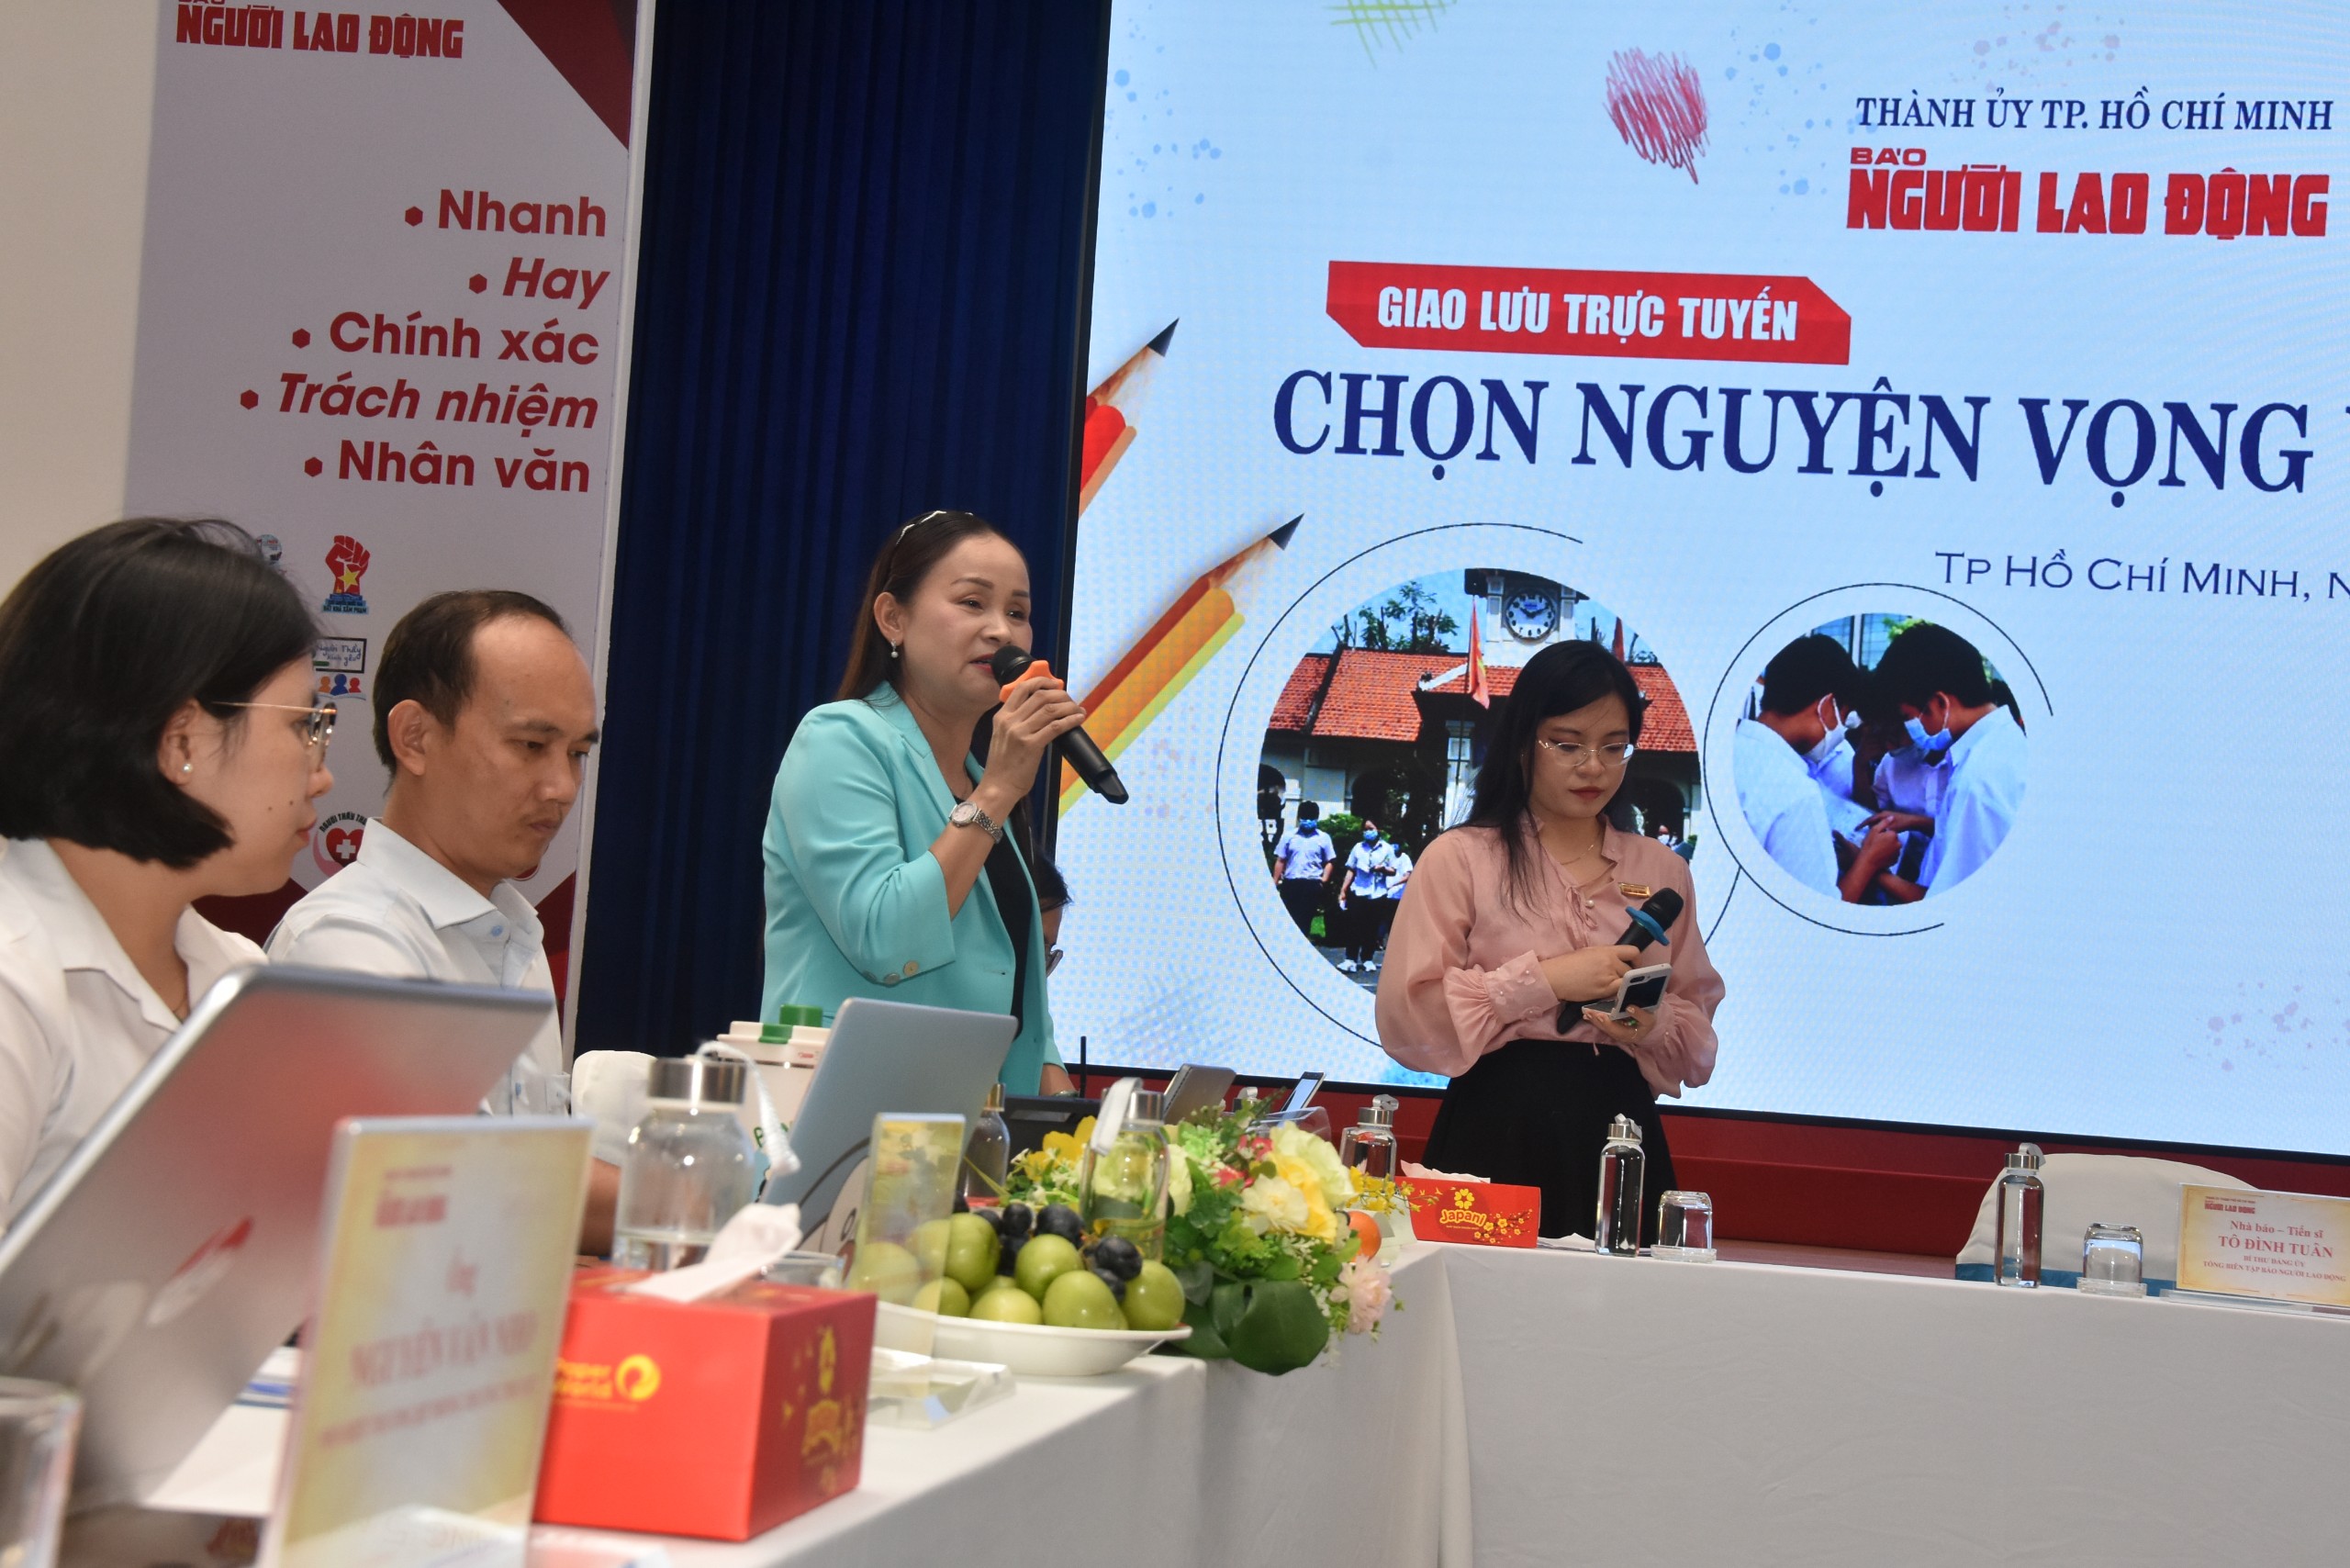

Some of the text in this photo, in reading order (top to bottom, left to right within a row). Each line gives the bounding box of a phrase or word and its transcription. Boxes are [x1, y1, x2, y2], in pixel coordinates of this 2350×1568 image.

[176, 5, 464, 59] NGƯỜI LAO ĐỘNG
[1856, 85, 2333, 130] THÀNH ỦY TP. HỒ CHÍ MINH
[1850, 147, 1927, 166] BÁO
[438, 188, 607, 237] Nhanh
[1846, 164, 2329, 240] NGƯỜI LAO ĐỘNG
[502, 256, 610, 309] Hay
[330, 310, 599, 365] Chính xác
[1378, 286, 1797, 344] GIAO LƯU TRỰC TUYẾN
[279, 371, 599, 438] Trách nhiệm
[339, 439, 589, 492] Nhân văn
[1273, 369, 2314, 509] CHỌN NGUYỆN VỌNG
[2005, 548, 2073, 588] HỒ
[2218, 1234, 2241, 1249] TÔ
[2244, 1236, 2284, 1253] ĐÌNH
[2231, 1220, 2252, 1231] Nhà
[2255, 1223, 2275, 1234] báo
[2287, 1225, 2311, 1238] Tiến
